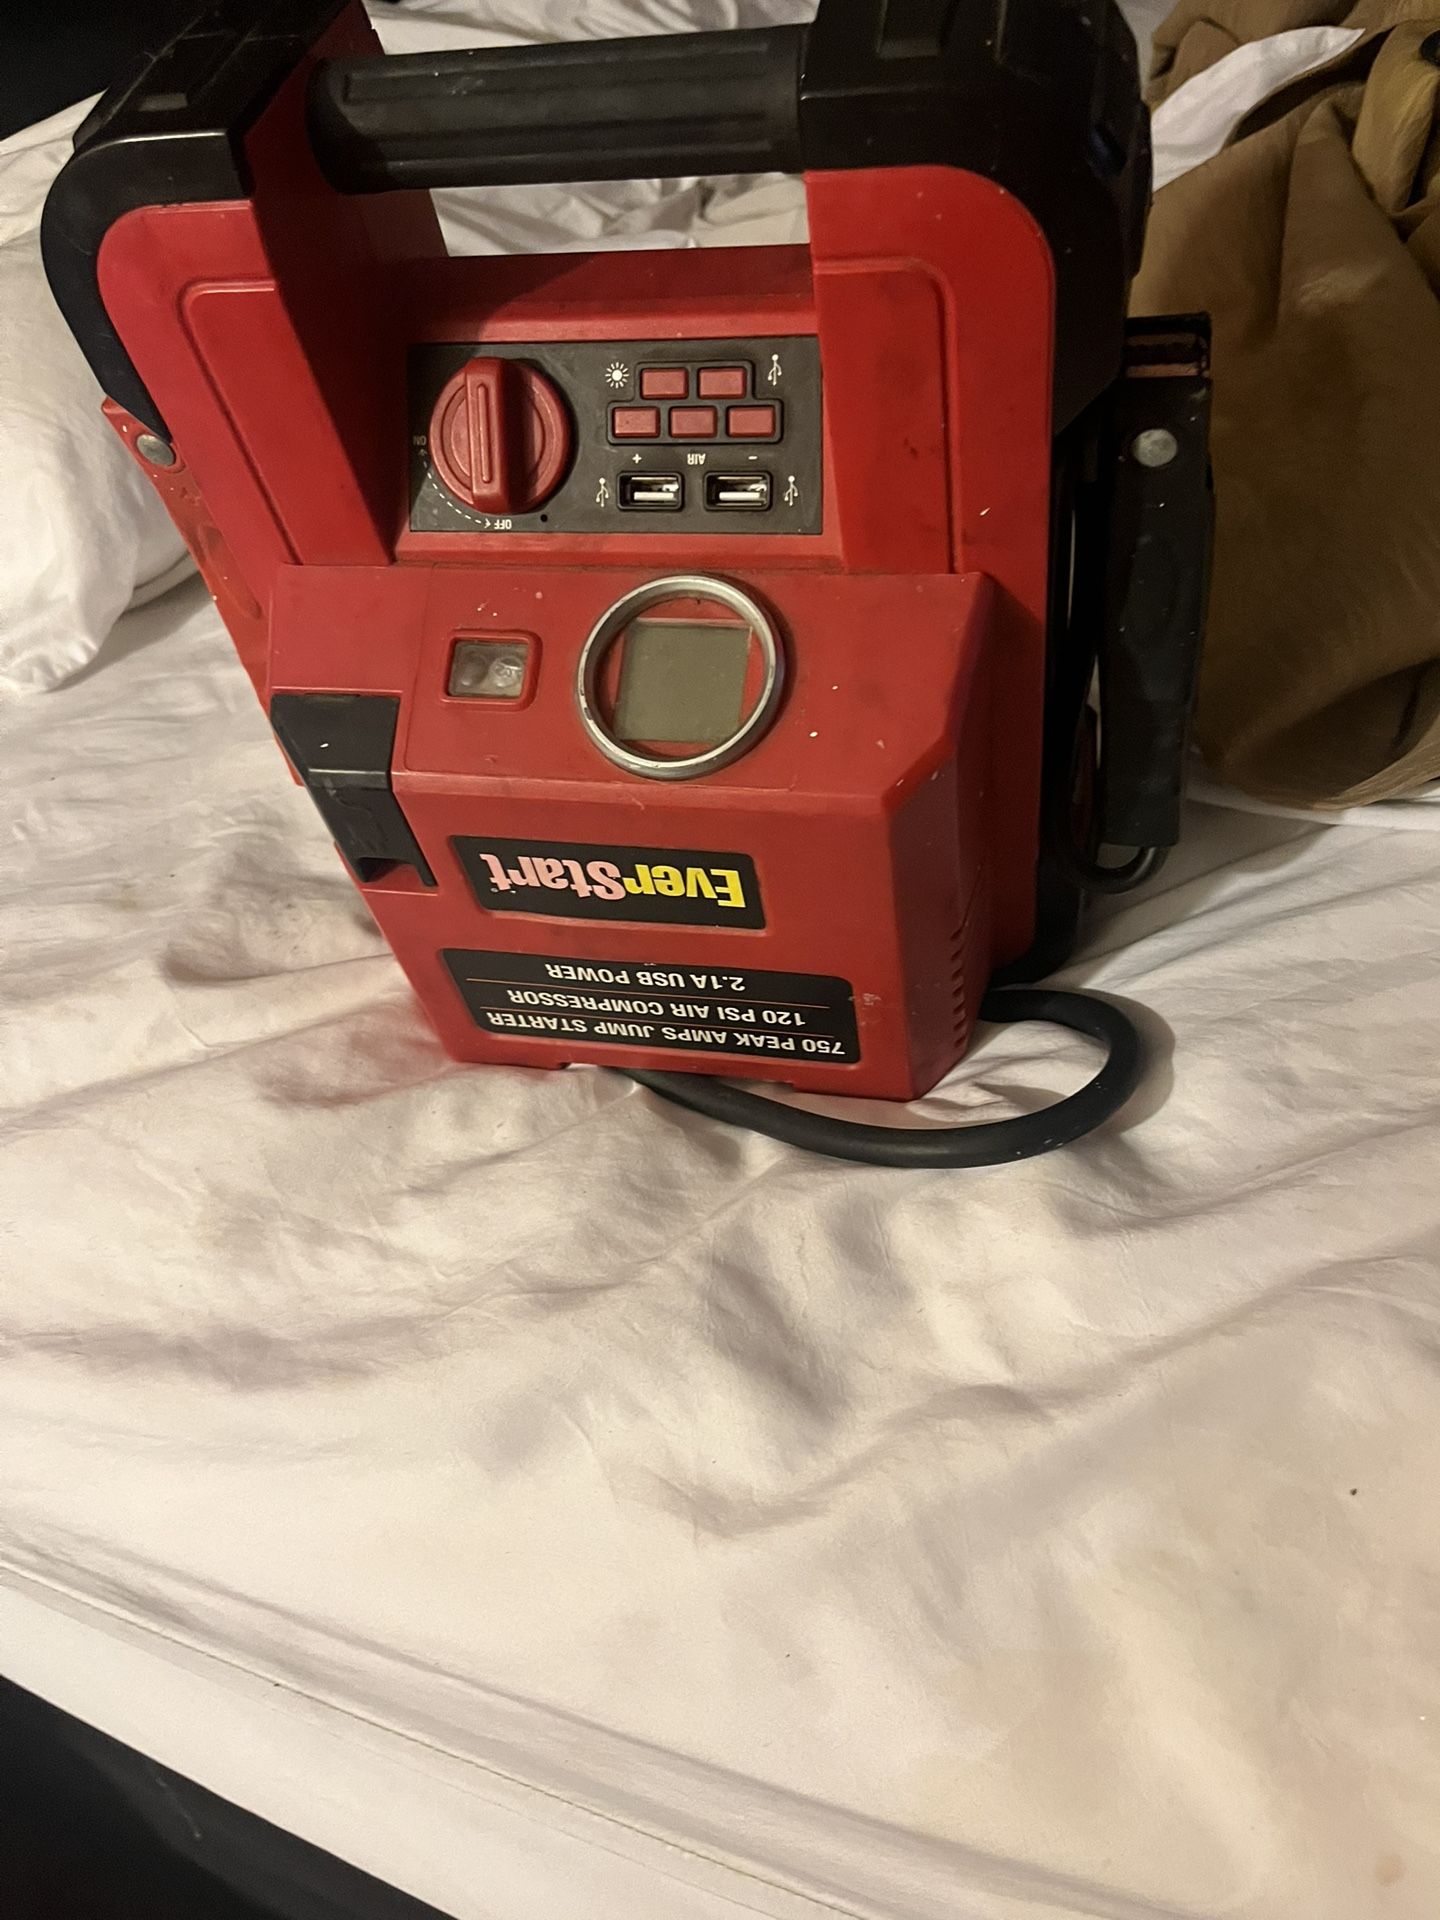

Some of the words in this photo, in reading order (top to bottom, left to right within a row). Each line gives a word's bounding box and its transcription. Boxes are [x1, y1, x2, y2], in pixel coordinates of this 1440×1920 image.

[412, 435, 427, 446] ON
[687, 453, 706, 465] AIR
[493, 519, 512, 530] OFF
[479, 853, 746, 908] EverStart
[544, 963, 631, 985] POWER
[636, 971, 686, 988] USB
[690, 974, 746, 991] 2.1A
[507, 989, 664, 1016] COMPRESSOR
[670, 1003, 709, 1019] AIR
[486, 1012, 588, 1033] STARTER
[716, 1006, 756, 1023] PSI
[762, 1010, 806, 1026] 120
[594, 1021, 654, 1038] JUMP
[661, 1027, 727, 1044] AMPS
[733, 1032, 795, 1050] PEAK
[802, 1038, 846, 1055] 750
